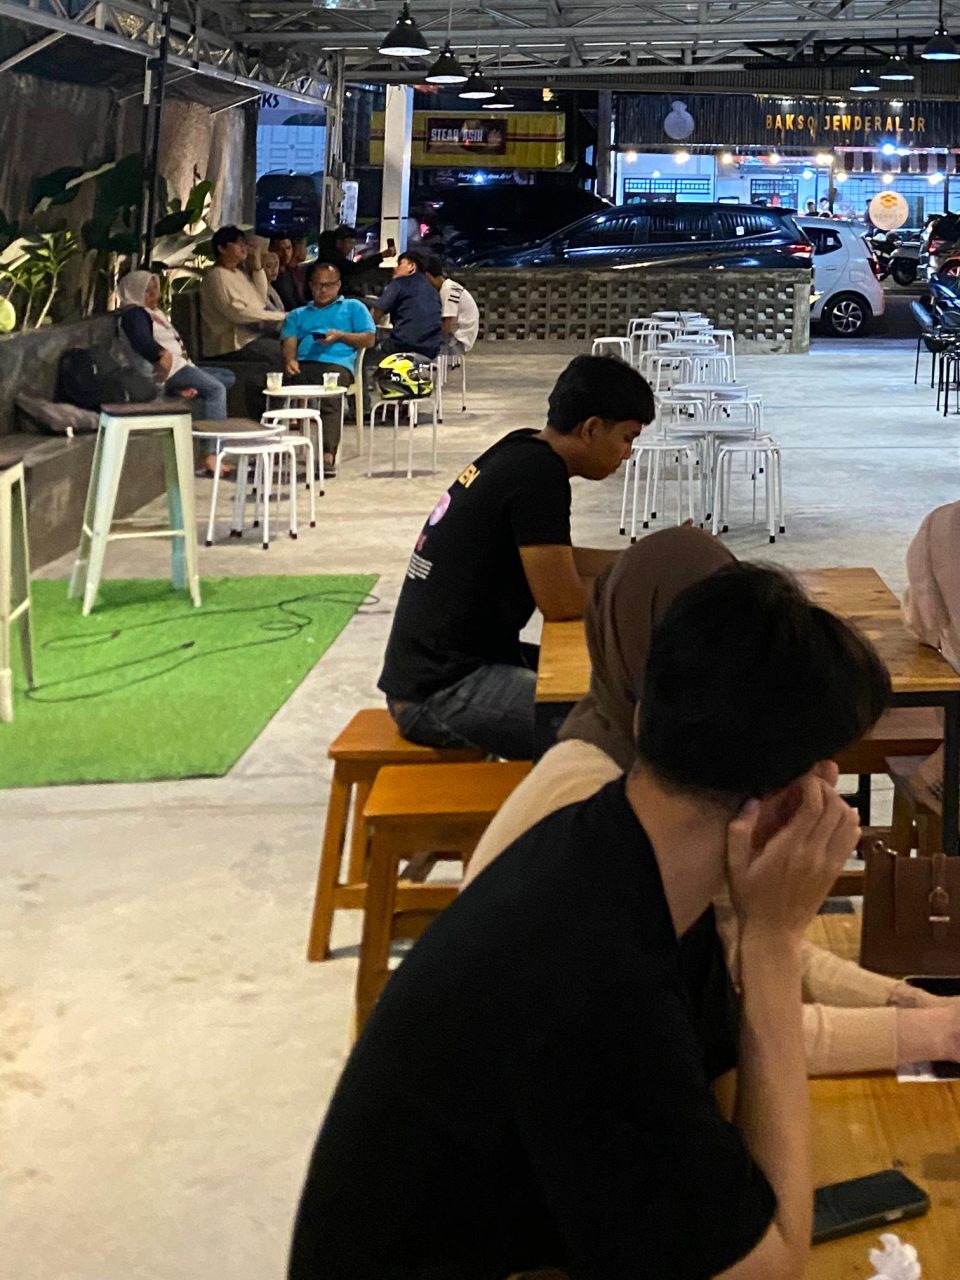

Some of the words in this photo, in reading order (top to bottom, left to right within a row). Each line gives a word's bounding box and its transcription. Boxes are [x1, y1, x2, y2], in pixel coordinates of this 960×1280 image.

[766, 114, 815, 130] BAKSO
[824, 114, 904, 132] JENDERAL
[909, 116, 926, 132] JR
